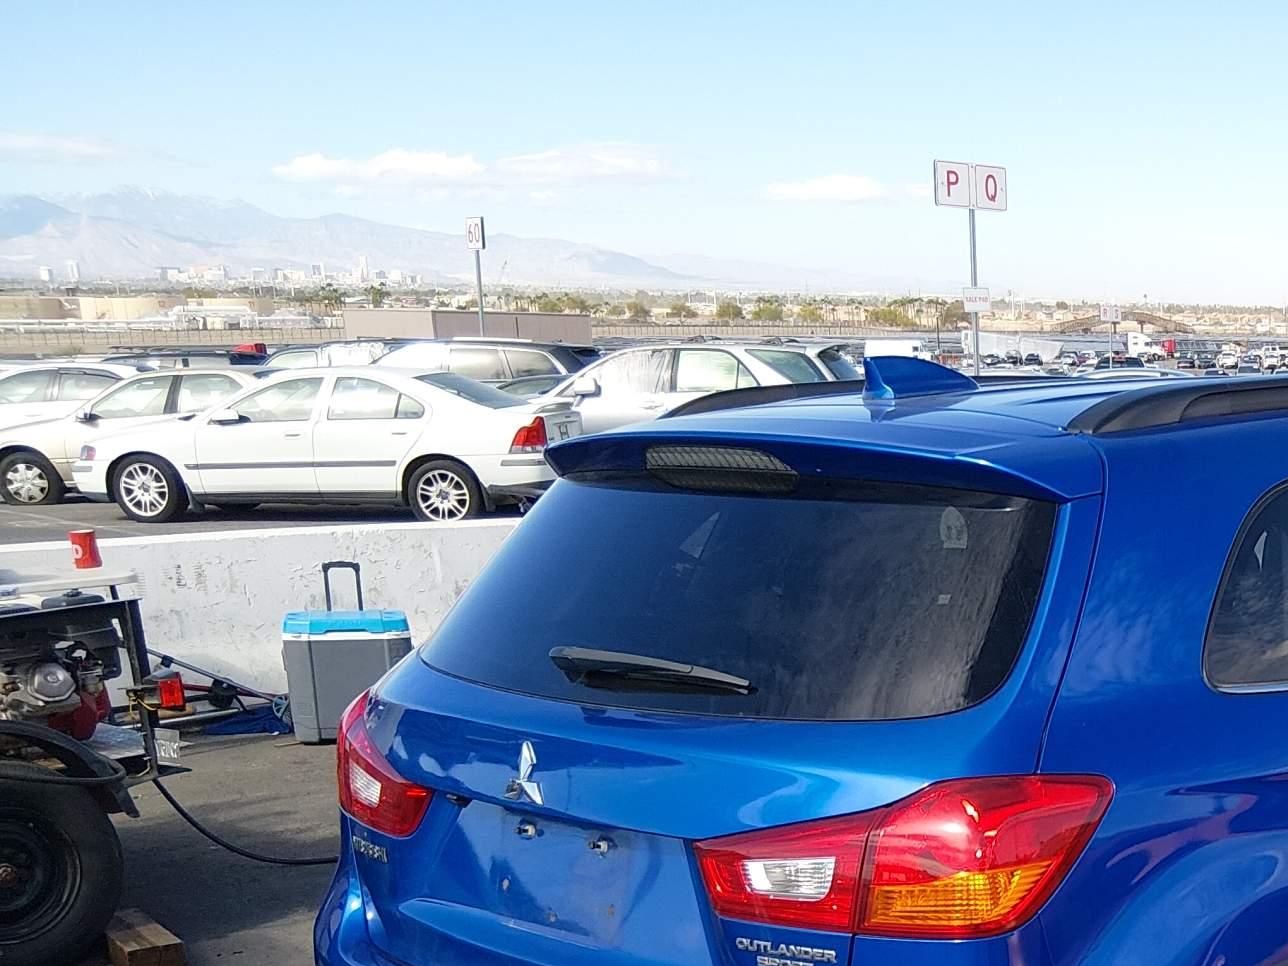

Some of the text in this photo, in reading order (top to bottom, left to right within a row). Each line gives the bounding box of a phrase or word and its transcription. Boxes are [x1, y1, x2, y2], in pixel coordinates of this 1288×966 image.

[946, 169, 960, 198] P
[985, 174, 998, 203] Q
[468, 223, 480, 244] 60
[735, 937, 838, 964] OUTLANDER
